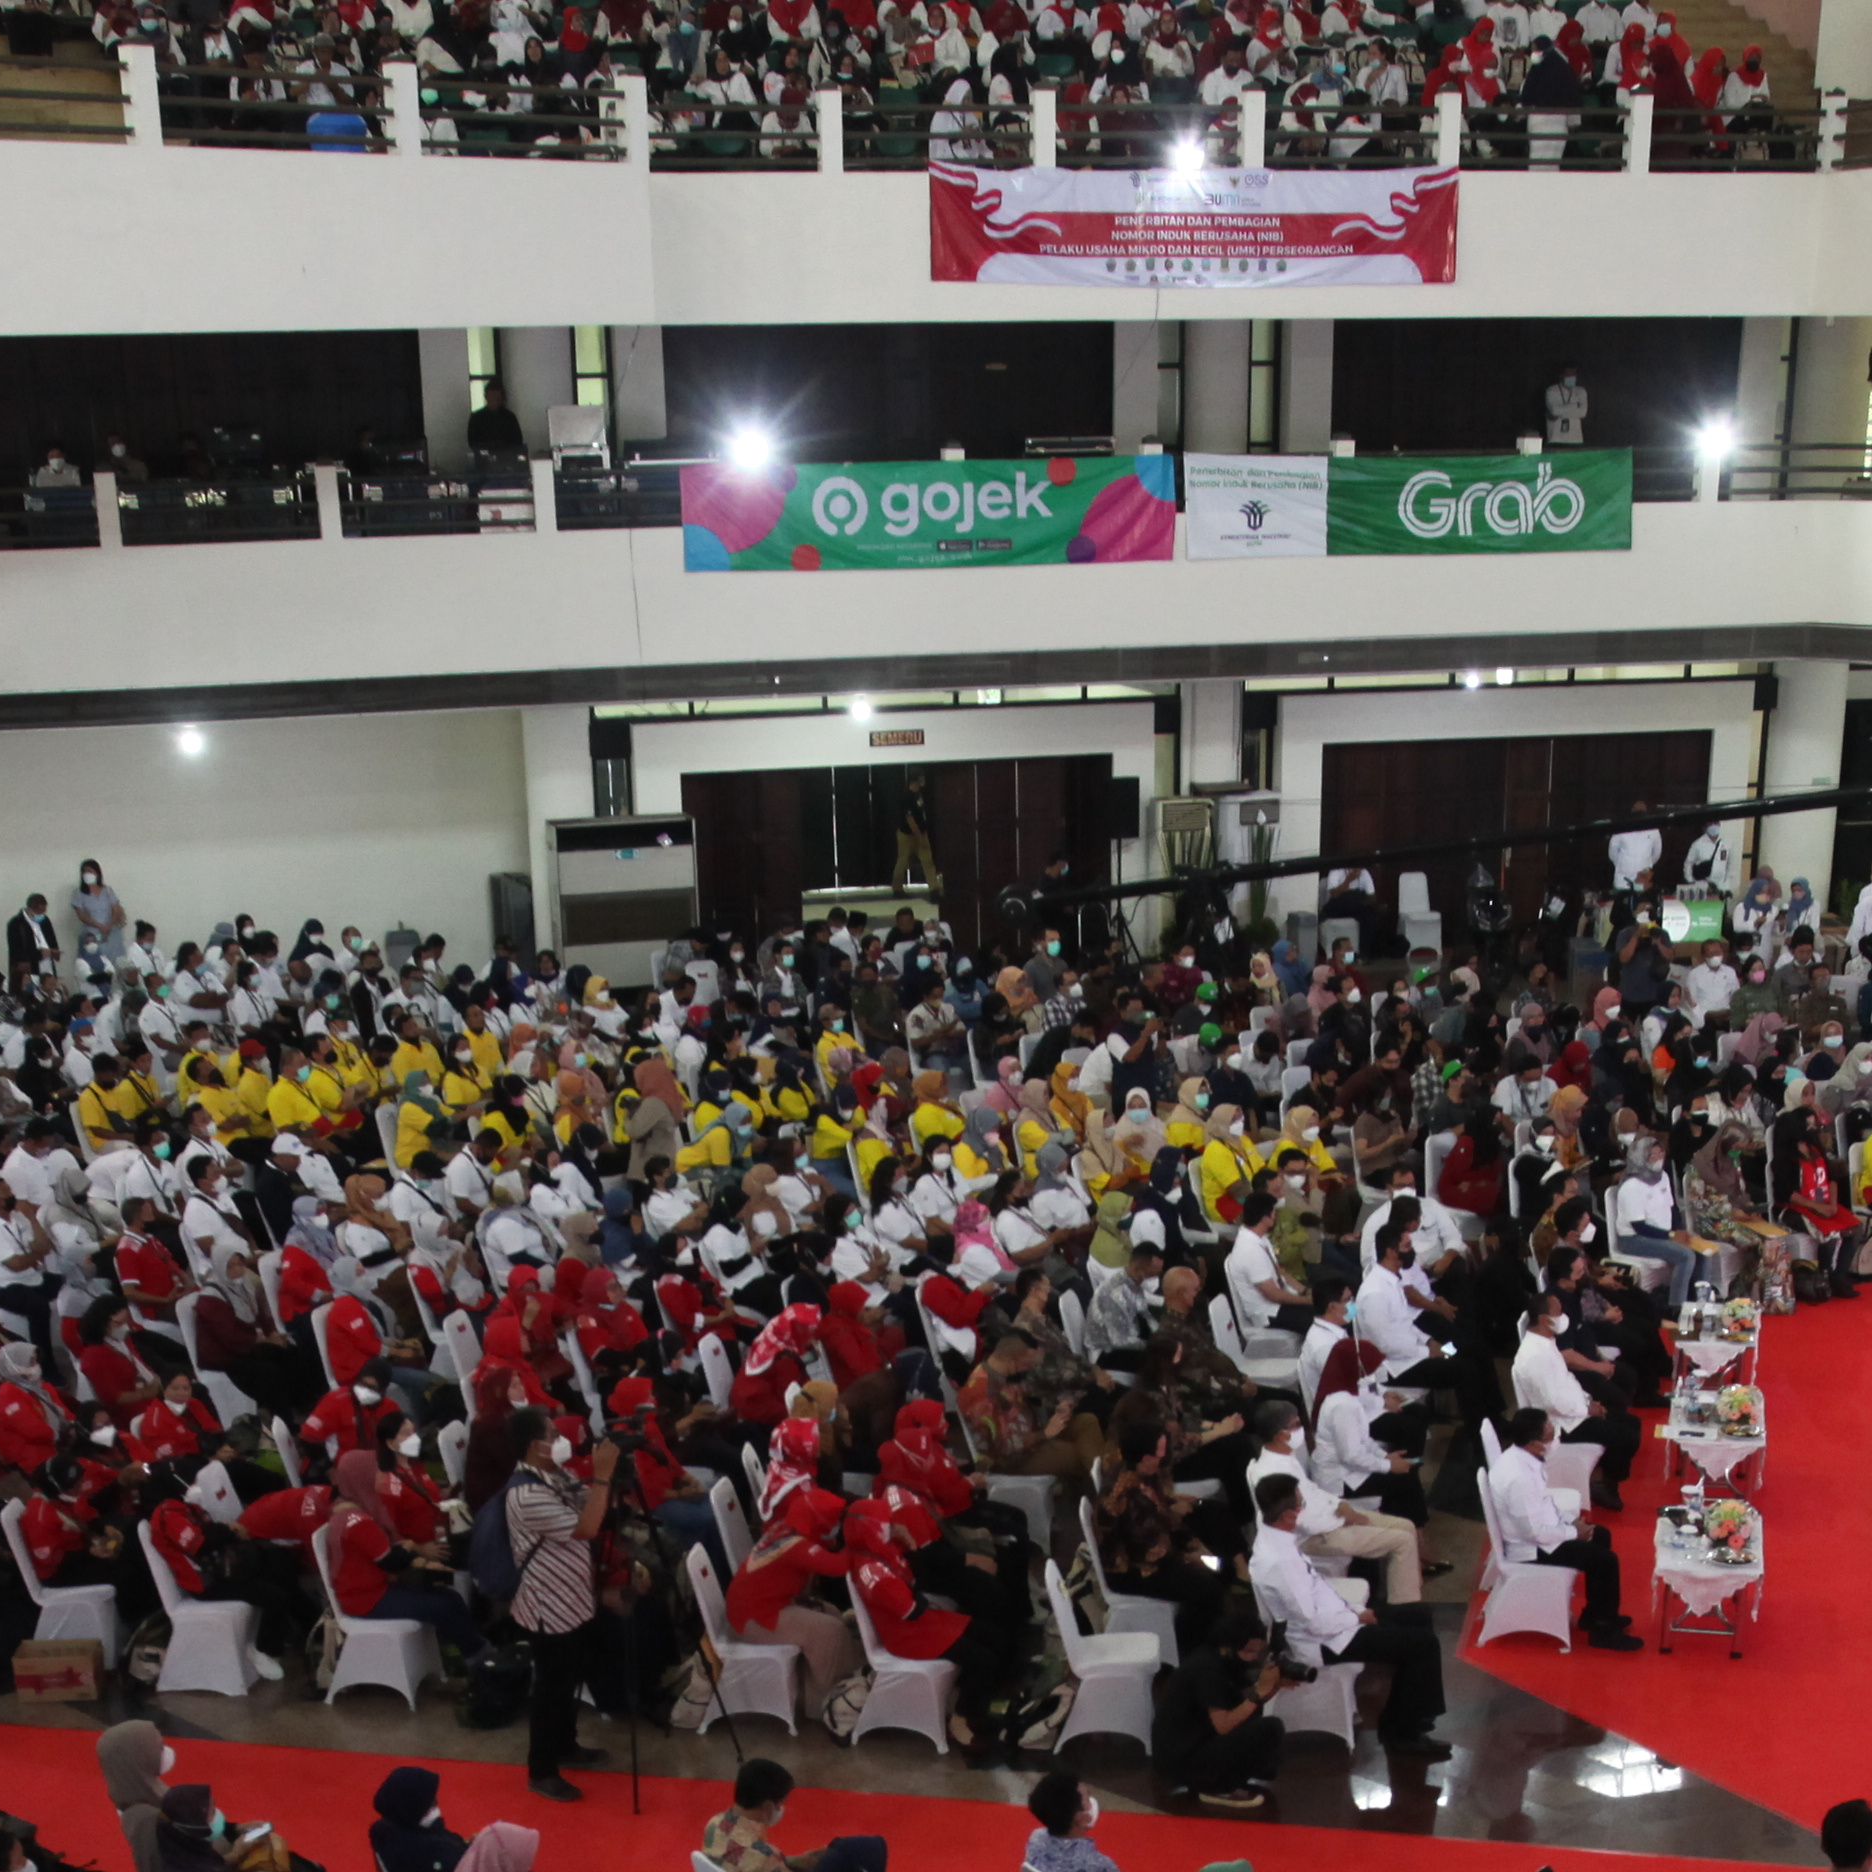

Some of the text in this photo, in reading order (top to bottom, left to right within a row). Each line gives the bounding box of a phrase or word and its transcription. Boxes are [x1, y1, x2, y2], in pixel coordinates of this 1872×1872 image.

[1244, 174, 1270, 186] OSS
[1114, 215, 1281, 228] PENERBITAN DAN PEMBAGIAN
[1111, 229, 1284, 243] NOMOR INDUK BERUSAHA (NIB)
[1039, 243, 1354, 257] PELAKU USAHA MIKRO DAN KECIL (UMK) PERSEORANGAN
[1190, 466, 1321, 480] Penerbitan dan Pembagian
[1189, 480, 1220, 488] Nomor
[1251, 480, 1296, 490] Berusaha
[1298, 481, 1323, 491] (NIB)
[880, 471, 1054, 537] gojek
[1397, 461, 1586, 538] Grab
[872, 731, 923, 746] SEMERU
